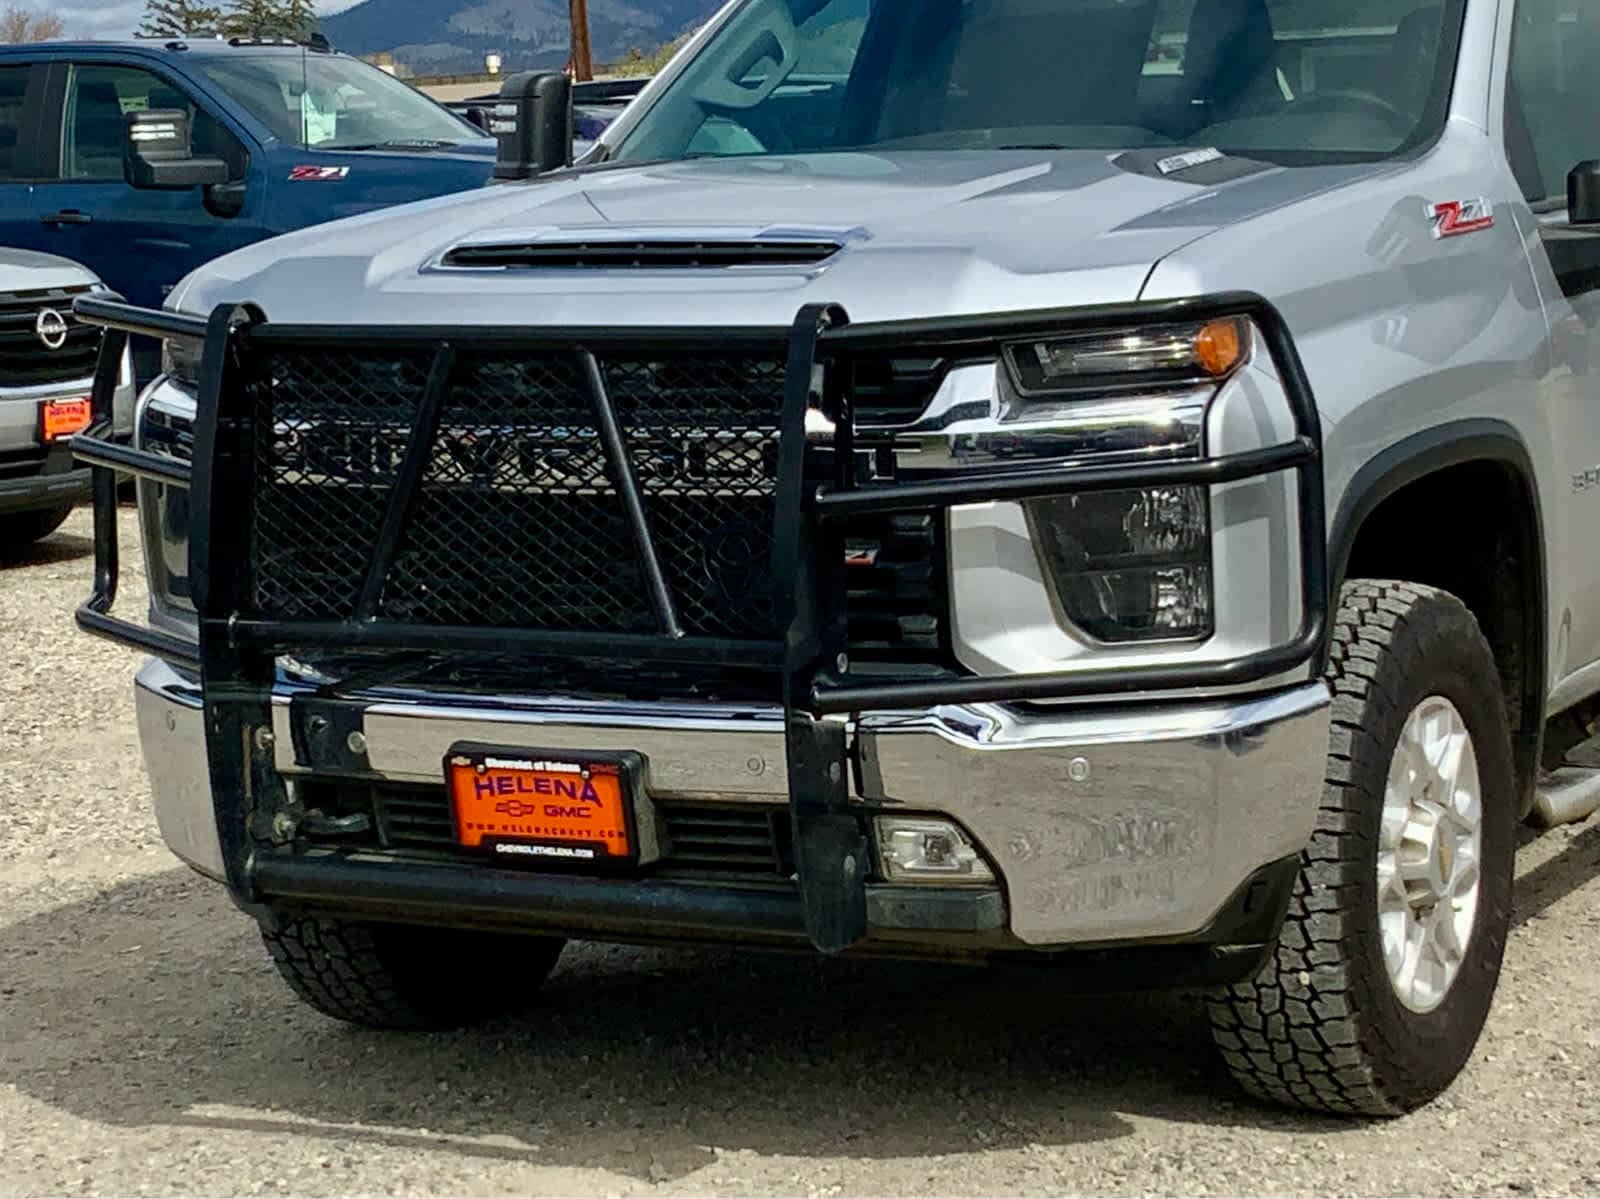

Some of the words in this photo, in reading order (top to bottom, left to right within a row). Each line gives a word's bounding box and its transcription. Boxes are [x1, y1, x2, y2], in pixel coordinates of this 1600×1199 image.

[287, 165, 351, 180] Z71
[1427, 198, 1494, 240] Z71
[474, 776, 603, 808] HELENA
[544, 805, 591, 818] GMC
